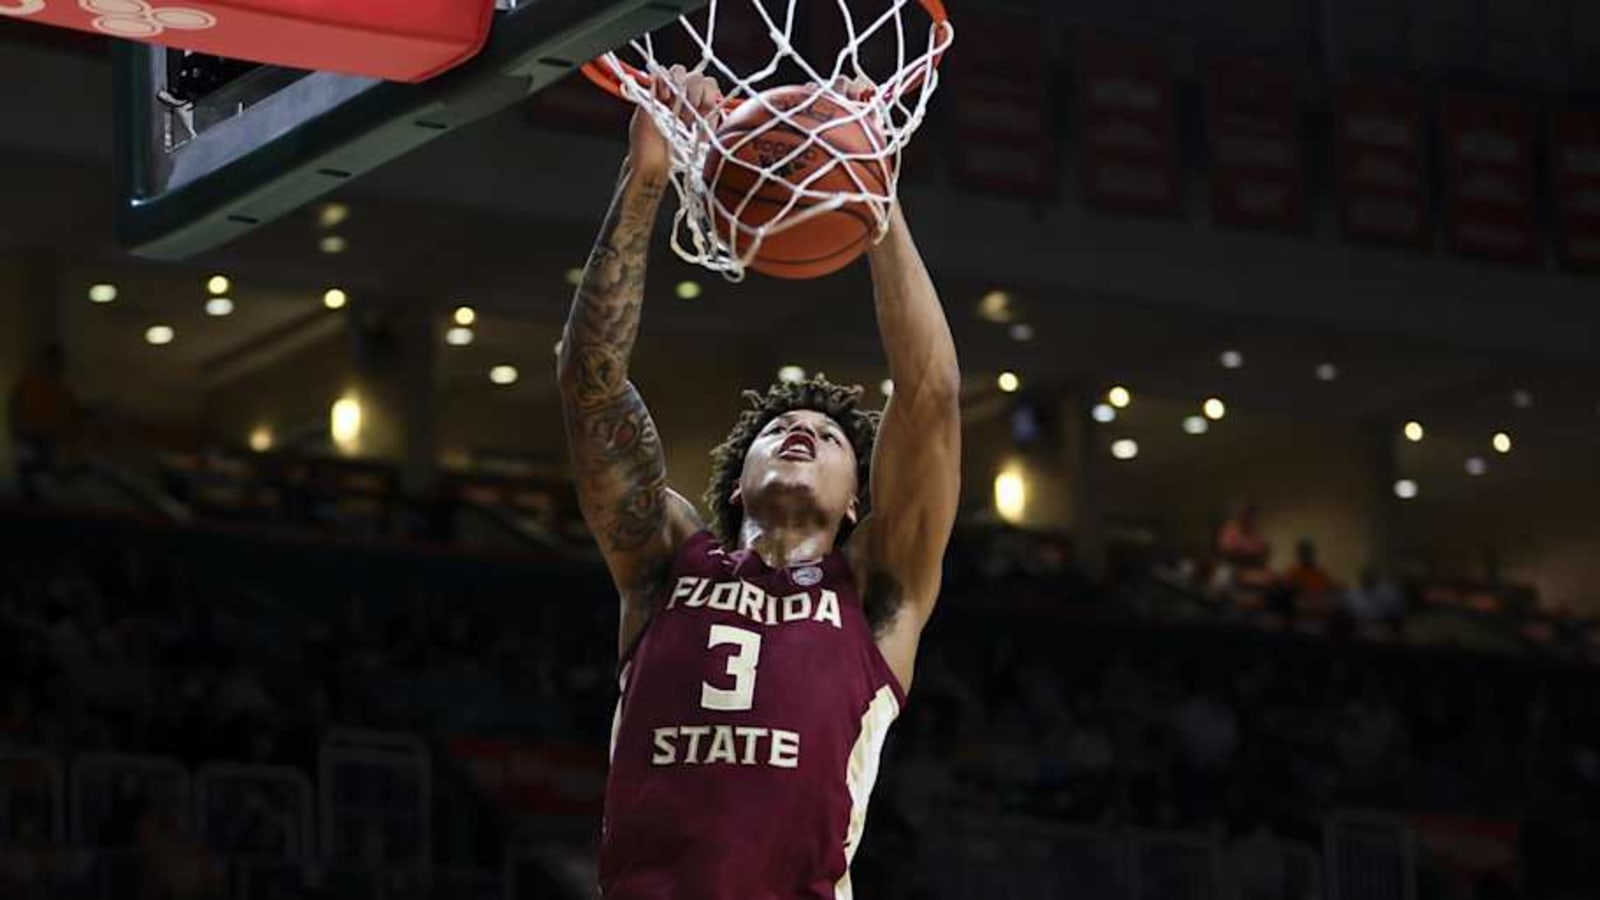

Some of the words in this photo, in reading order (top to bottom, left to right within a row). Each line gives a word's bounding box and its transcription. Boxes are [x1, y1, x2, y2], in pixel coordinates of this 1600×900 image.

[666, 576, 842, 629] FLORIDA
[701, 624, 761, 710] 3
[652, 725, 800, 768] STATE
